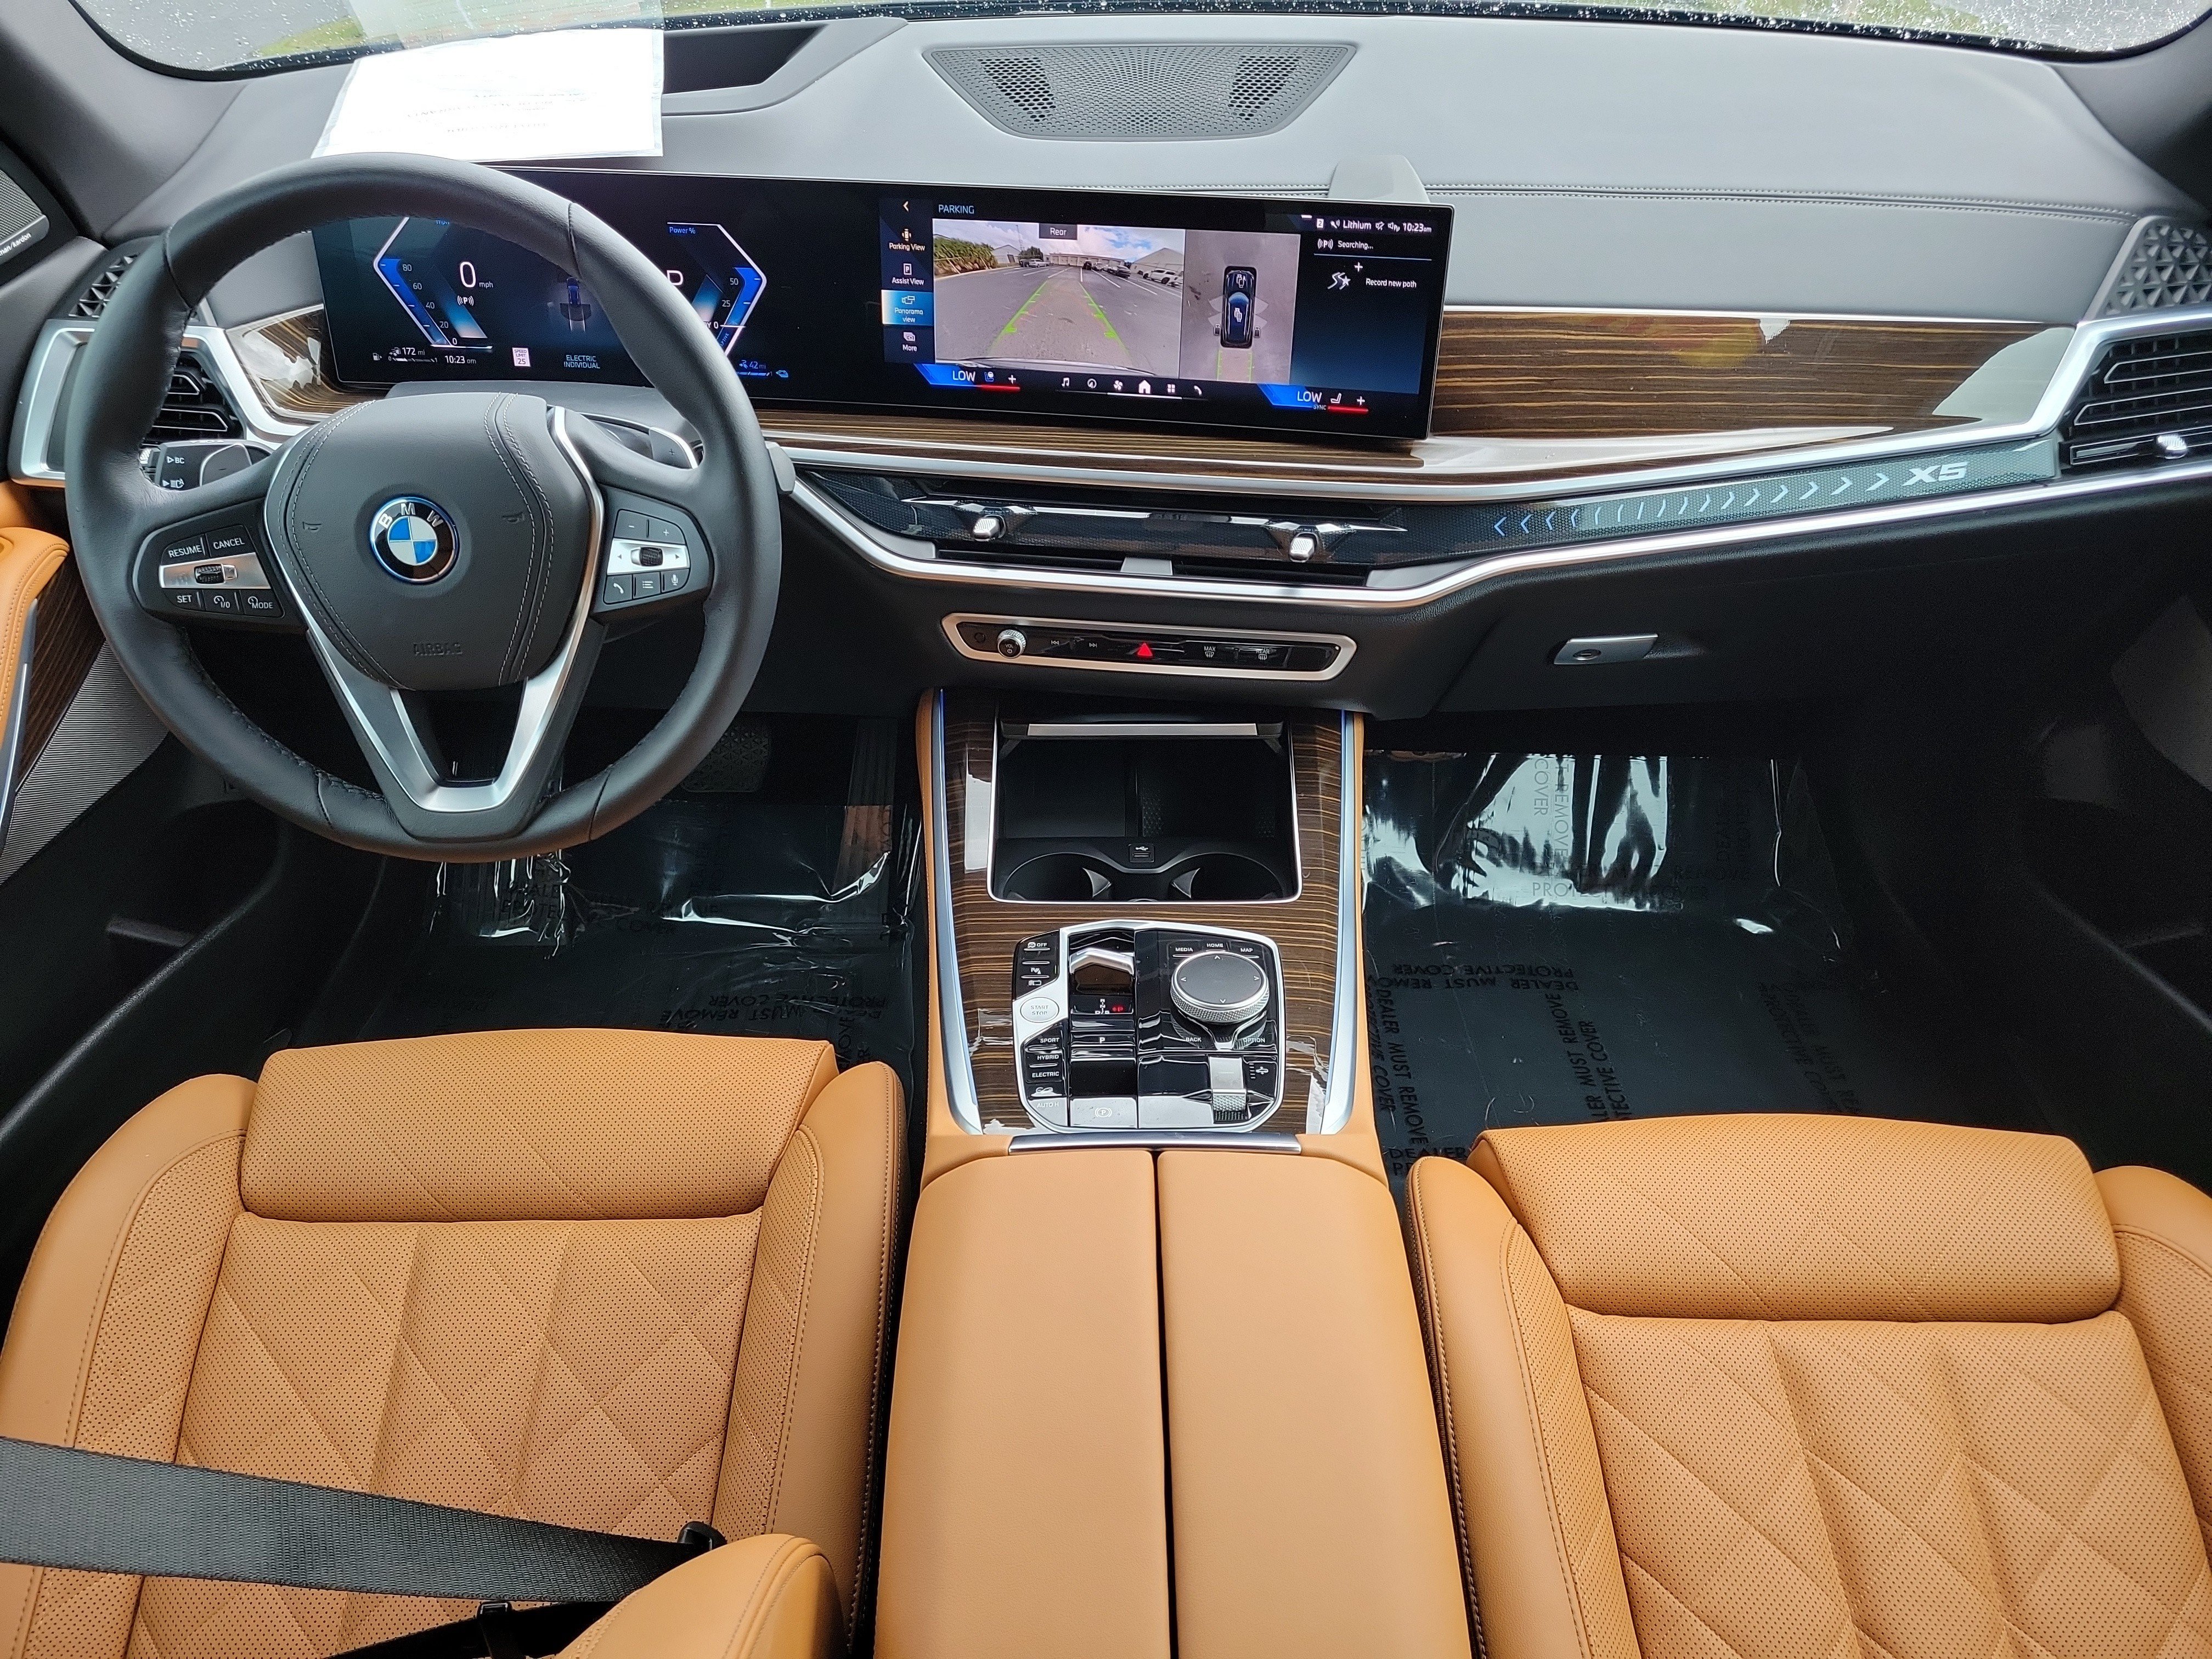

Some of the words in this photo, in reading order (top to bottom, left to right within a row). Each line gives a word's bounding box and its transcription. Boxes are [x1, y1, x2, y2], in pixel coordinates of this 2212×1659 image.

[938, 205, 974, 215] PARKING
[1343, 220, 1372, 229] Lithium
[1049, 227, 1067, 236] Rear
[889, 243, 910, 252] Parking
[911, 244, 926, 252] View
[402, 263, 412, 272] 80
[459, 261, 477, 288] 0
[479, 280, 494, 289] mph
[413, 282, 422, 291] 60
[730, 278, 739, 286] 50
[1365, 277, 1387, 287] Record
[1388, 279, 1402, 287] new
[1402, 280, 1417, 289] path
[425, 301, 435, 309] 40
[894, 307, 924, 316] Panorama
[439, 320, 449, 329] 20
[713, 321, 719, 329] 0
[402, 347, 416, 356] 172
[444, 355, 465, 364] 10:23
[566, 354, 597, 363] ELECTRIC
[563, 361, 601, 369] INDIVIDUAL
[749, 361, 758, 369] 42
[952, 370, 976, 382] LOW
[1297, 391, 1322, 403] LOW
[1902, 461, 1968, 486] X5
[379, 502, 444, 528] BMW
[213, 537, 245, 550] CANCEL
[168, 545, 202, 558] RESUME
[177, 595, 192, 603] SET
[1533, 759, 1550, 816] COVER
[1554, 783, 1571, 864] REMOVE
[1391, 963, 1455, 976] COVER
[1463, 964, 1574, 978] PROTECTIVE
[1444, 977, 1497, 989] MUST
[1510, 978, 1578, 991] DEALER
[708, 994, 770, 1007] COVER
[1376, 989, 1400, 1035] DEALER
[1545, 993, 1579, 1044] REMOVE
[1578, 1020, 1610, 1063] COVER
[1387, 1042, 1412, 1079] MUST
[1567, 1050, 1598, 1088] MUST
[1373, 1064, 1396, 1111] COVER
[1399, 1086, 1429, 1145] REMOVE
